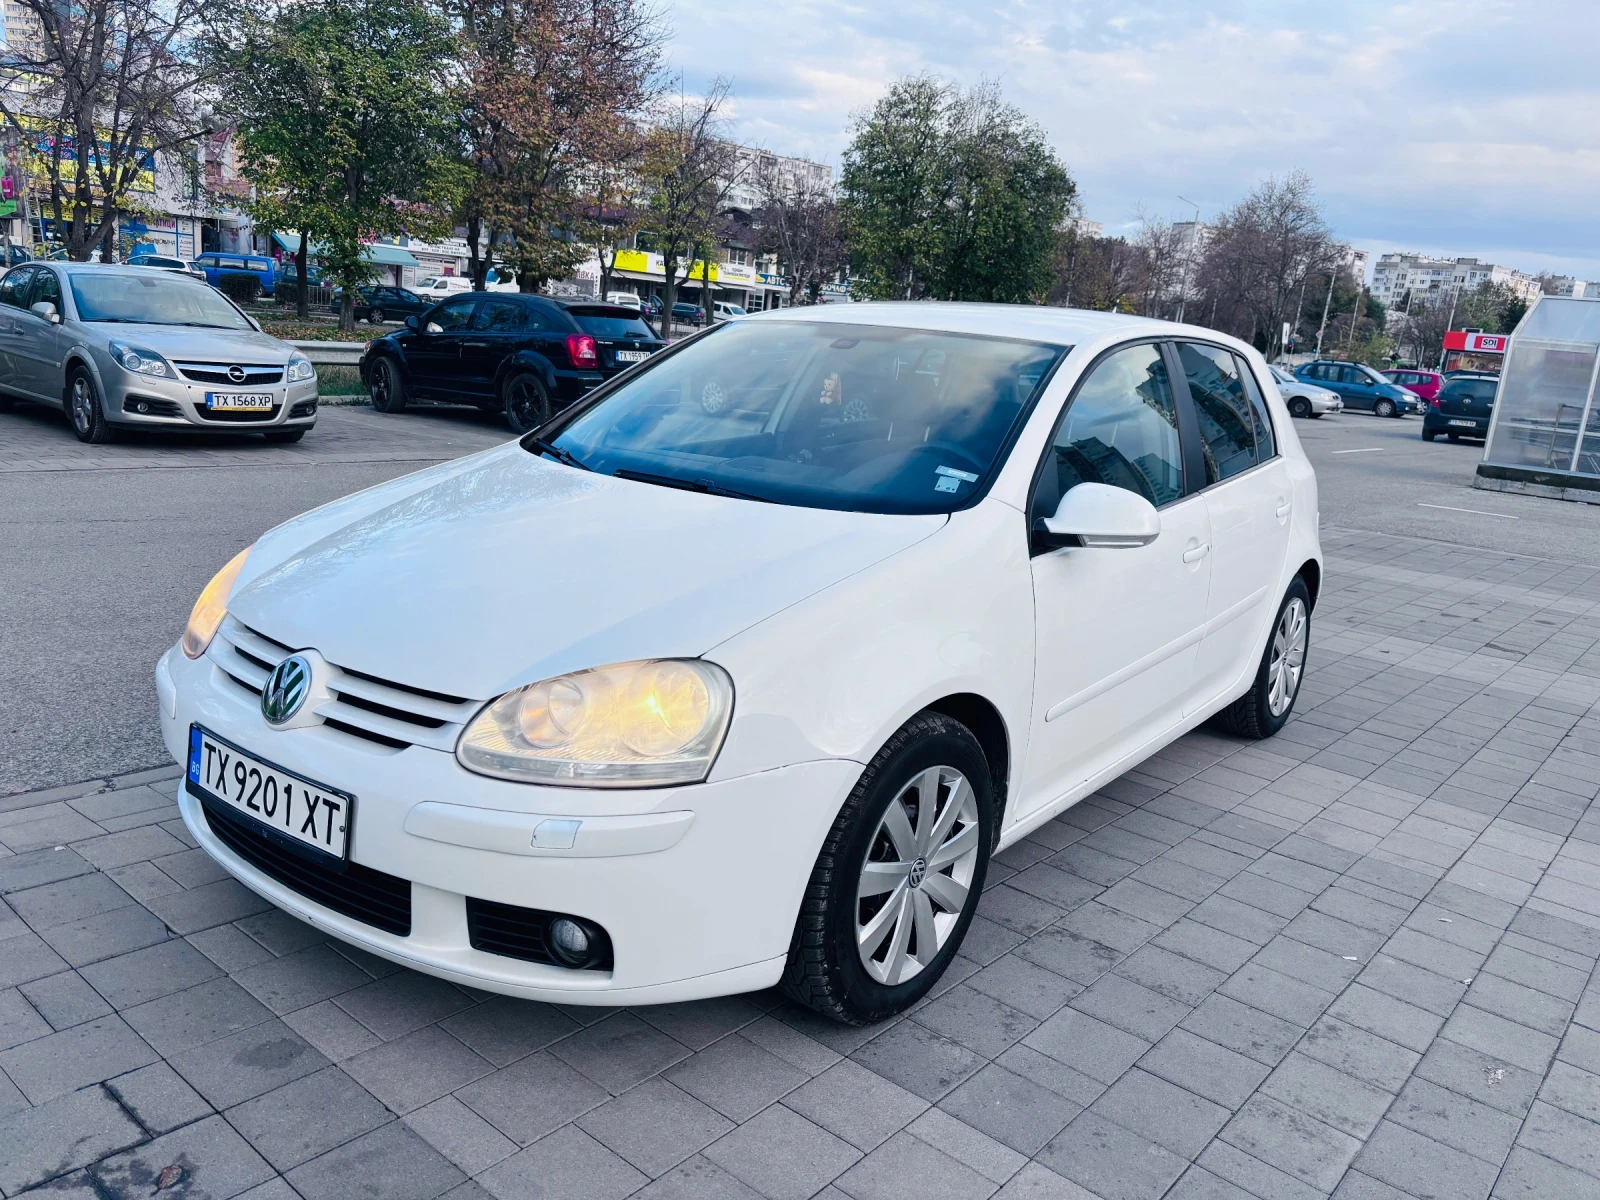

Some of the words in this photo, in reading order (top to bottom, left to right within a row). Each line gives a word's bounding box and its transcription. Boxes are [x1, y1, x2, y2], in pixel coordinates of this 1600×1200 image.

[1482, 338, 1497, 346] SDI
[619, 351, 628, 360] TX
[214, 395, 229, 406] TX
[232, 396, 256, 407] 1568
[258, 396, 271, 407] XP
[204, 741, 230, 795] TX
[234, 760, 293, 827] 9201
[300, 789, 341, 846] XT
